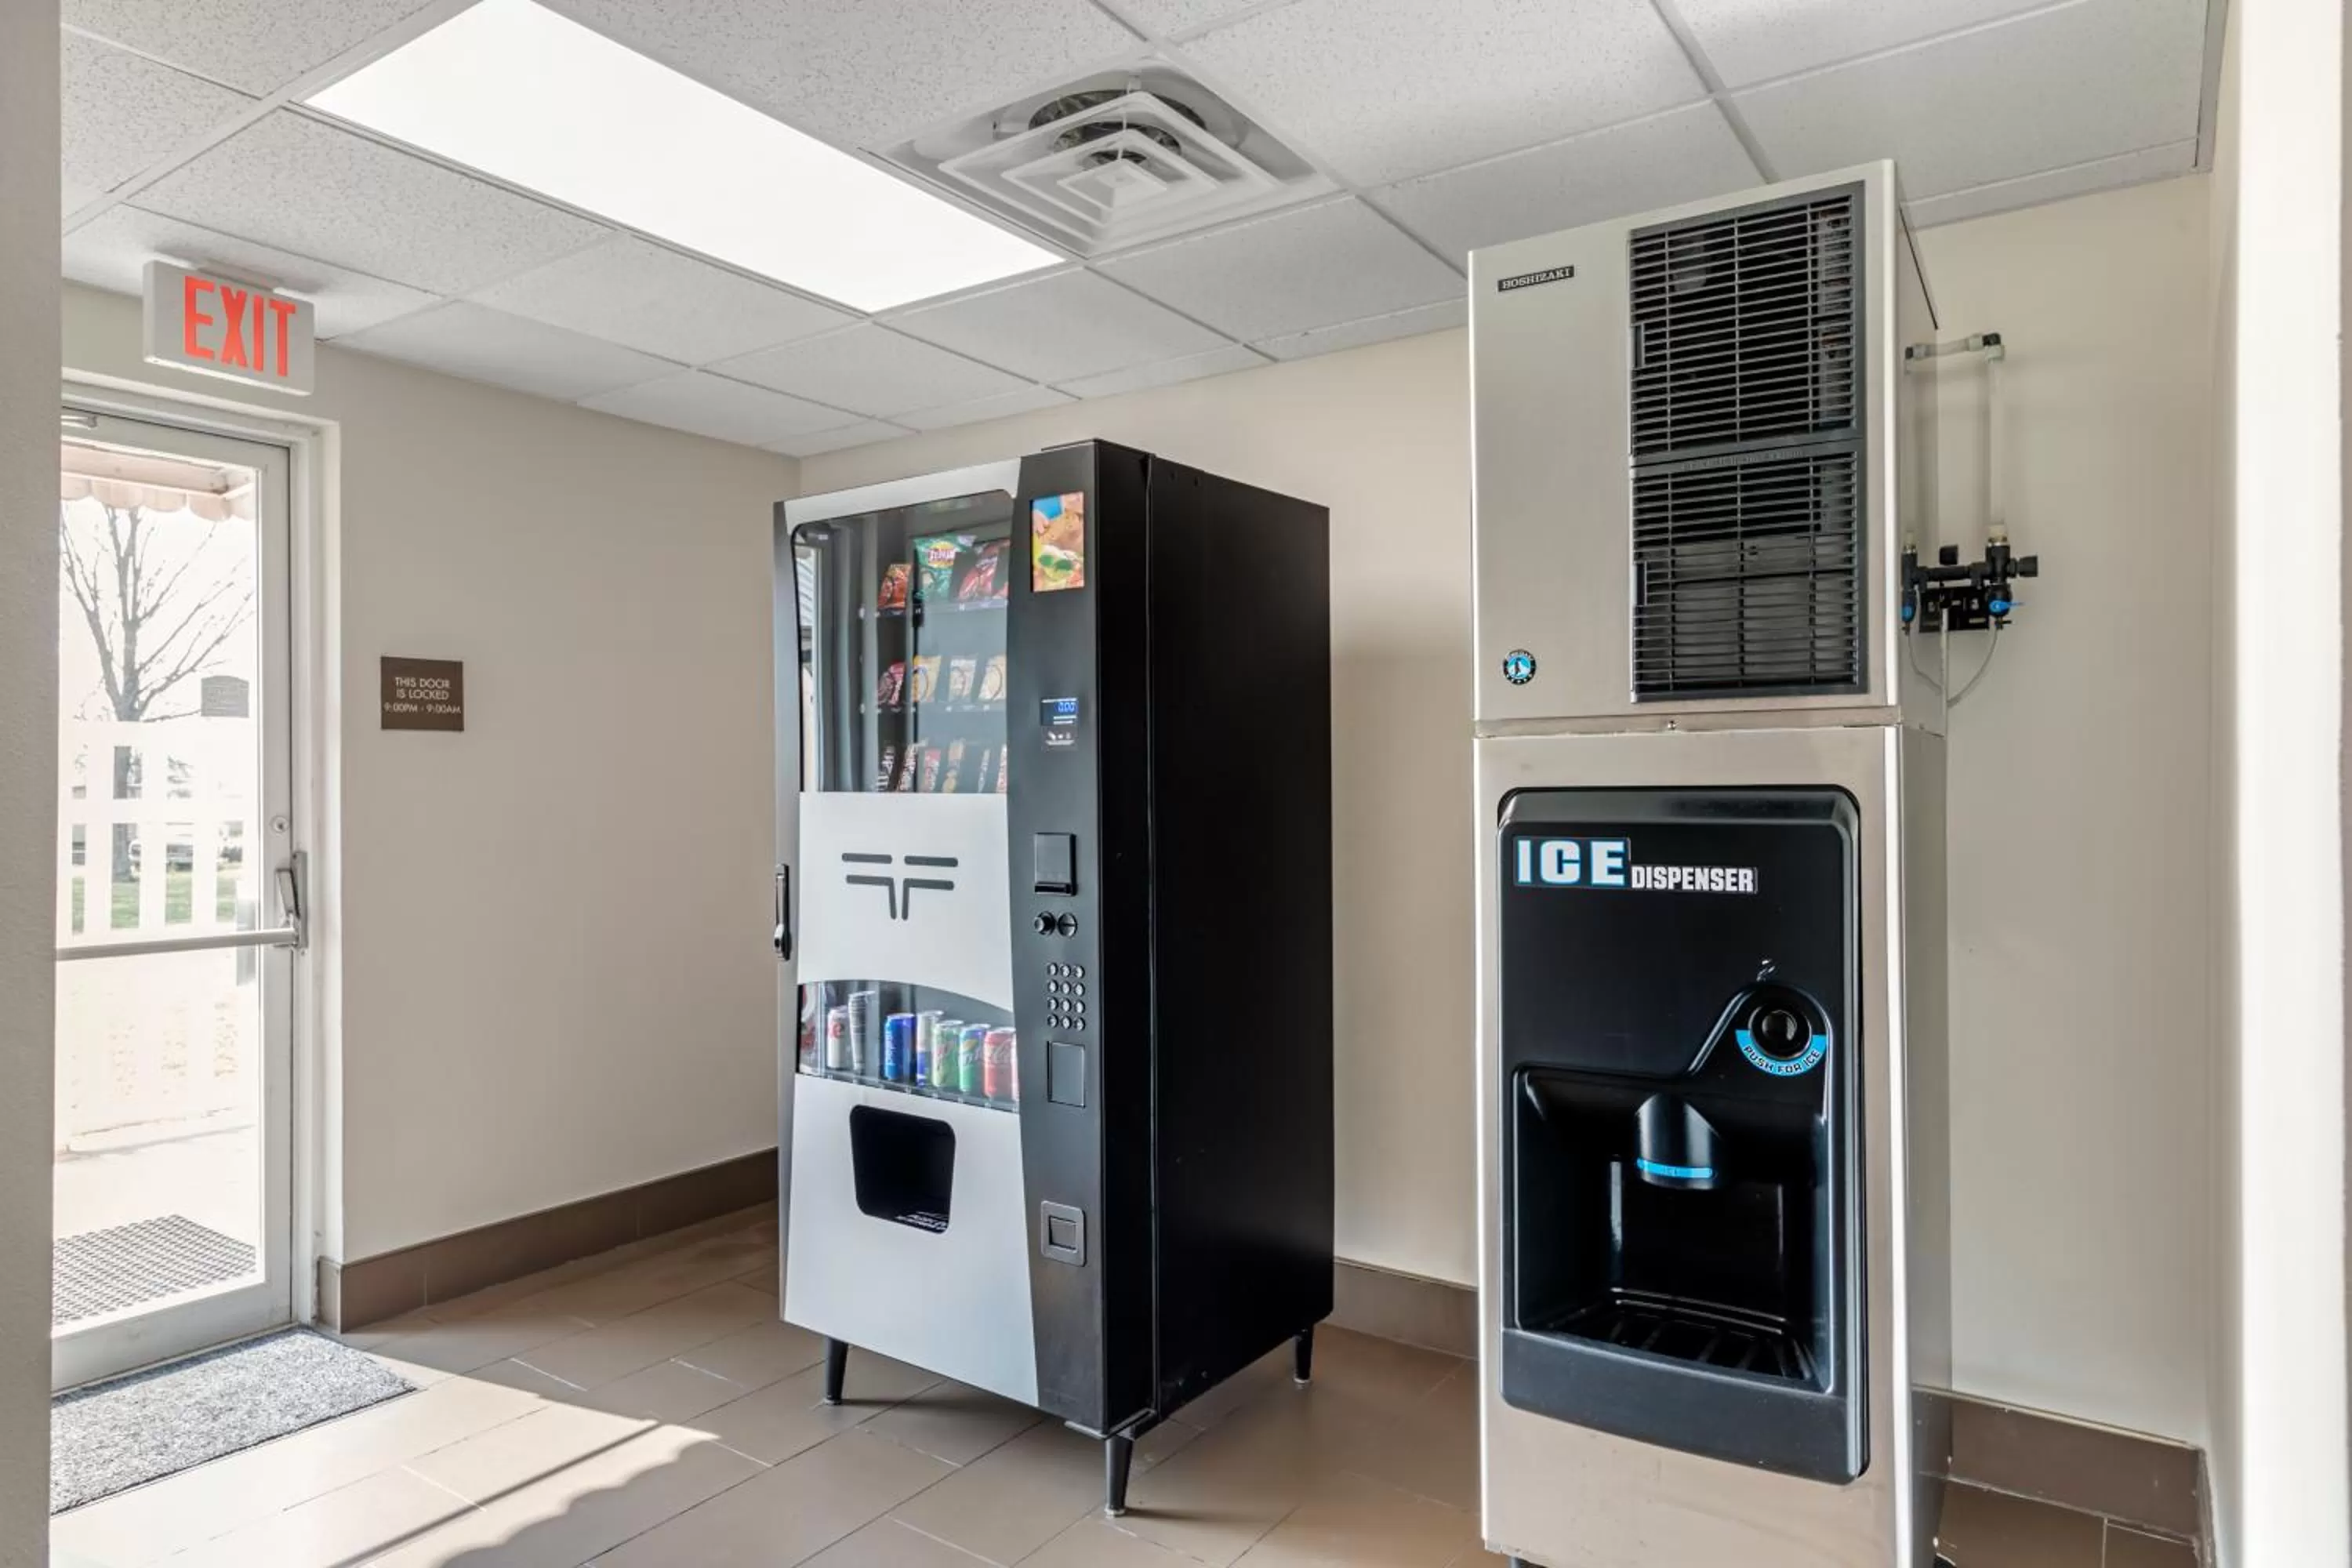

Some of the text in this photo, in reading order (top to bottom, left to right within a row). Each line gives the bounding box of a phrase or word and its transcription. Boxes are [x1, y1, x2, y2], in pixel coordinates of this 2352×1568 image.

[1502, 267, 1570, 289] HOSHIZAKI
[184, 275, 297, 377] EXIT
[395, 677, 451, 688] THIS DOOR
[396, 688, 449, 700] IS LOCKED
[1517, 840, 1754, 892] ICE DISPENSER
[1743, 1045, 1820, 1073] PUSH FOR ICE
